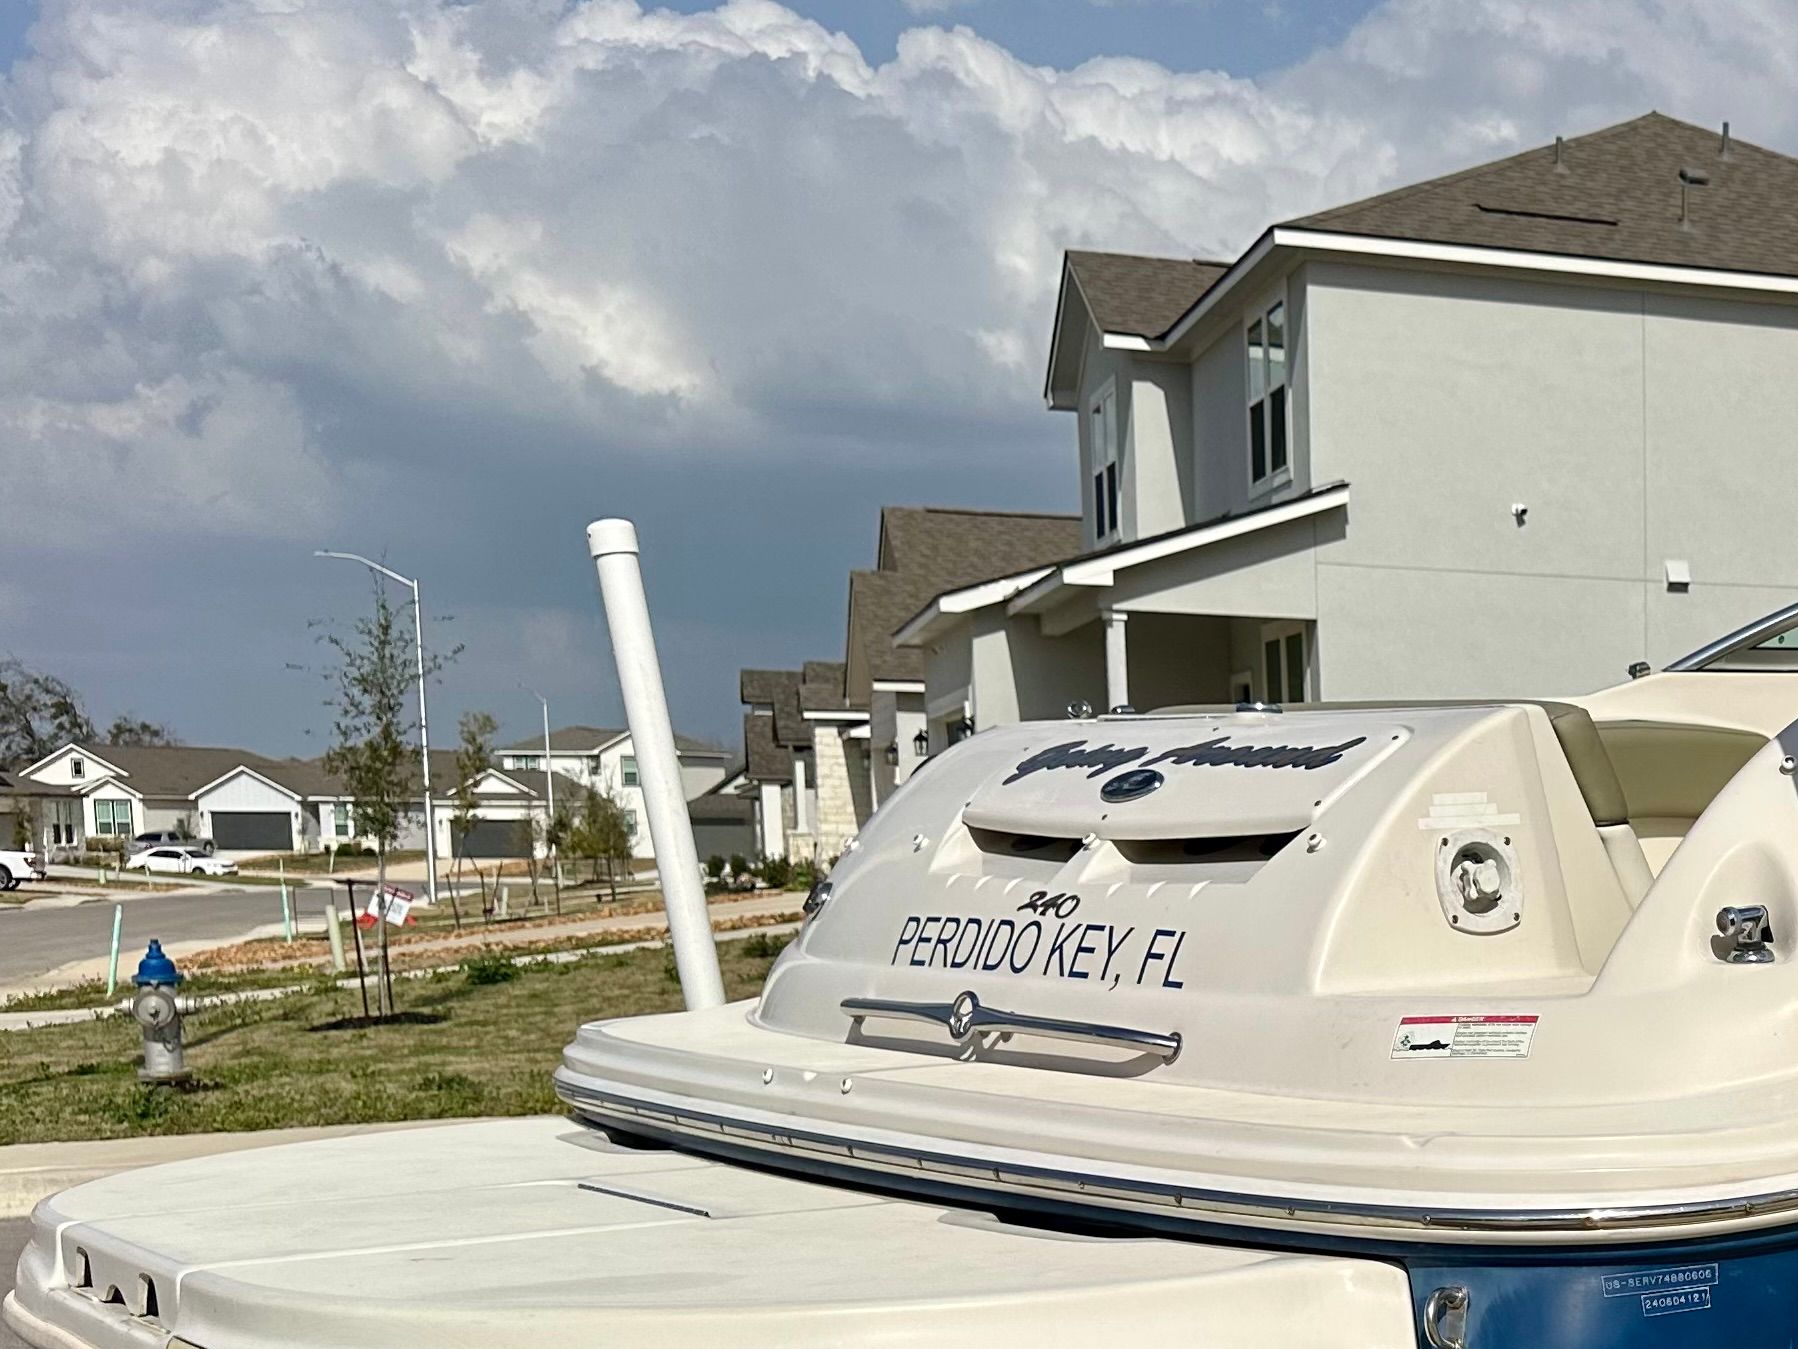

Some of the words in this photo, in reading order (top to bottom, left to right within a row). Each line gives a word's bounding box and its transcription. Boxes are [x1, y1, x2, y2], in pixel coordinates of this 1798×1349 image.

[1016, 890, 1081, 919] 240
[890, 916, 1042, 975] PERDIDO
[1042, 922, 1136, 991] KEY,
[1136, 928, 1187, 990] FL
